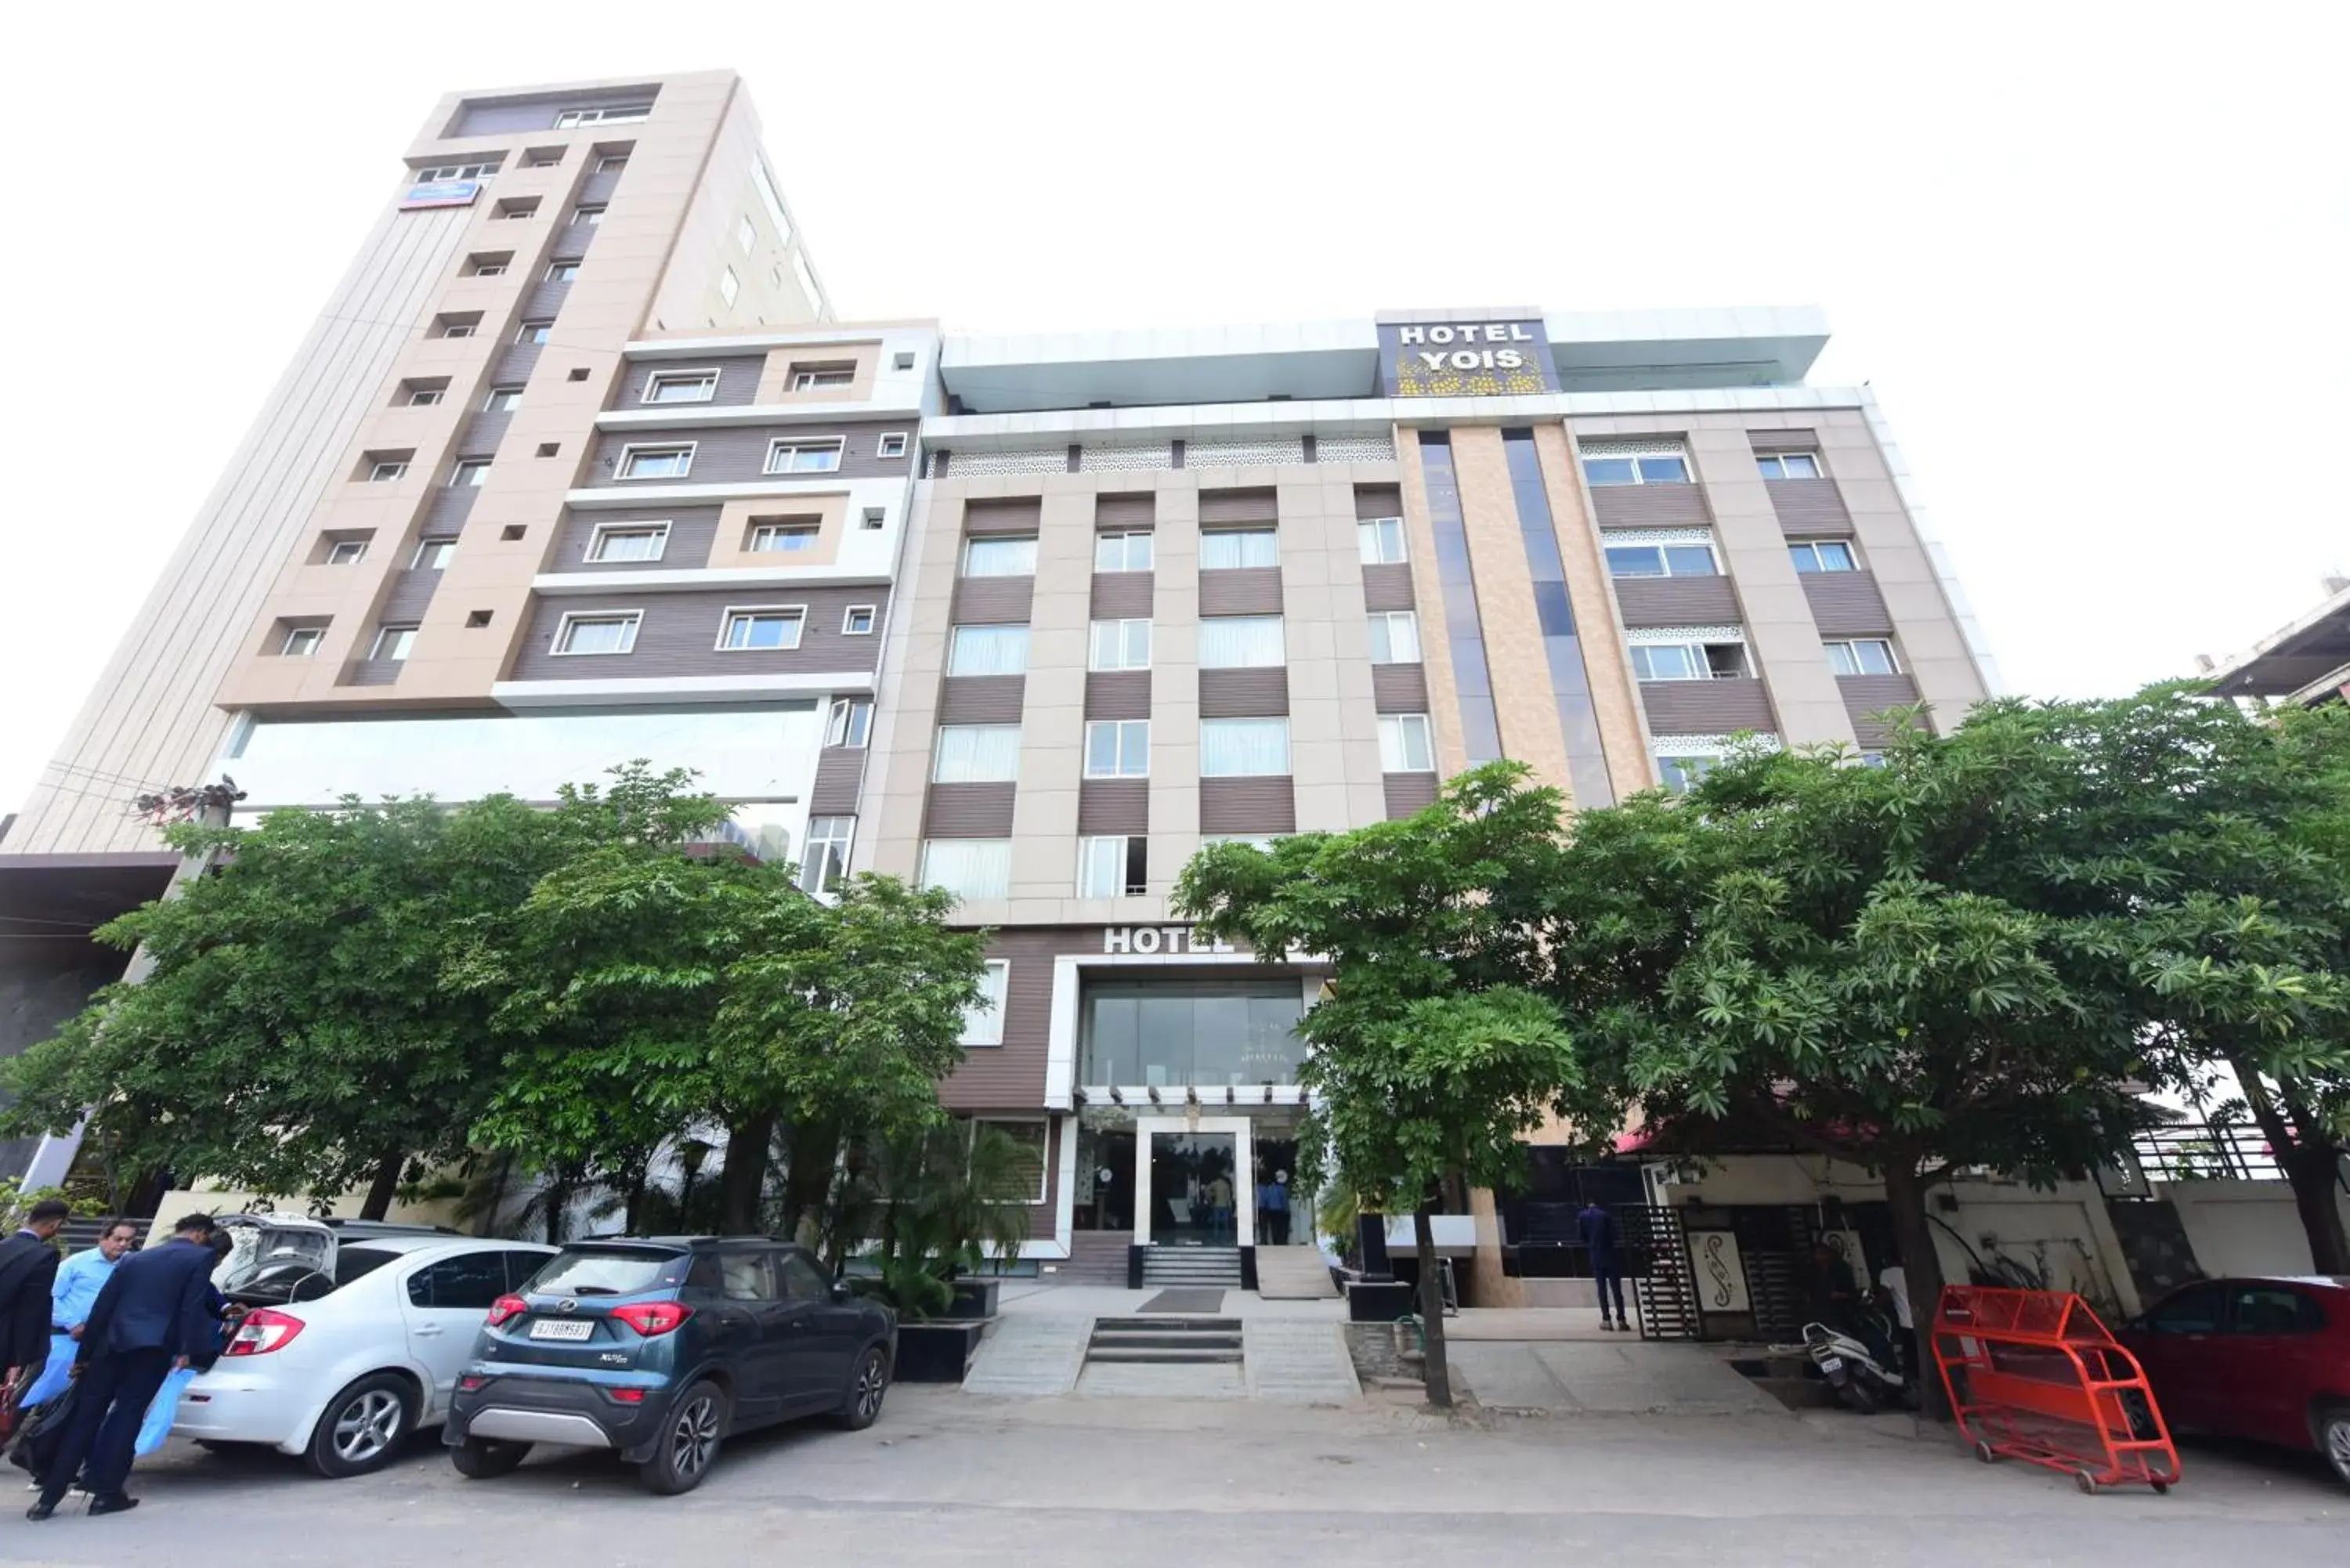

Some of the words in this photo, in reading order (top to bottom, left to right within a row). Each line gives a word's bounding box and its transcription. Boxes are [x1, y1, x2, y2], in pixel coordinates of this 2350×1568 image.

[1400, 324, 1533, 345] HOTEL
[1419, 349, 1522, 370] YOIS
[1104, 927, 1235, 953] HOTEL
